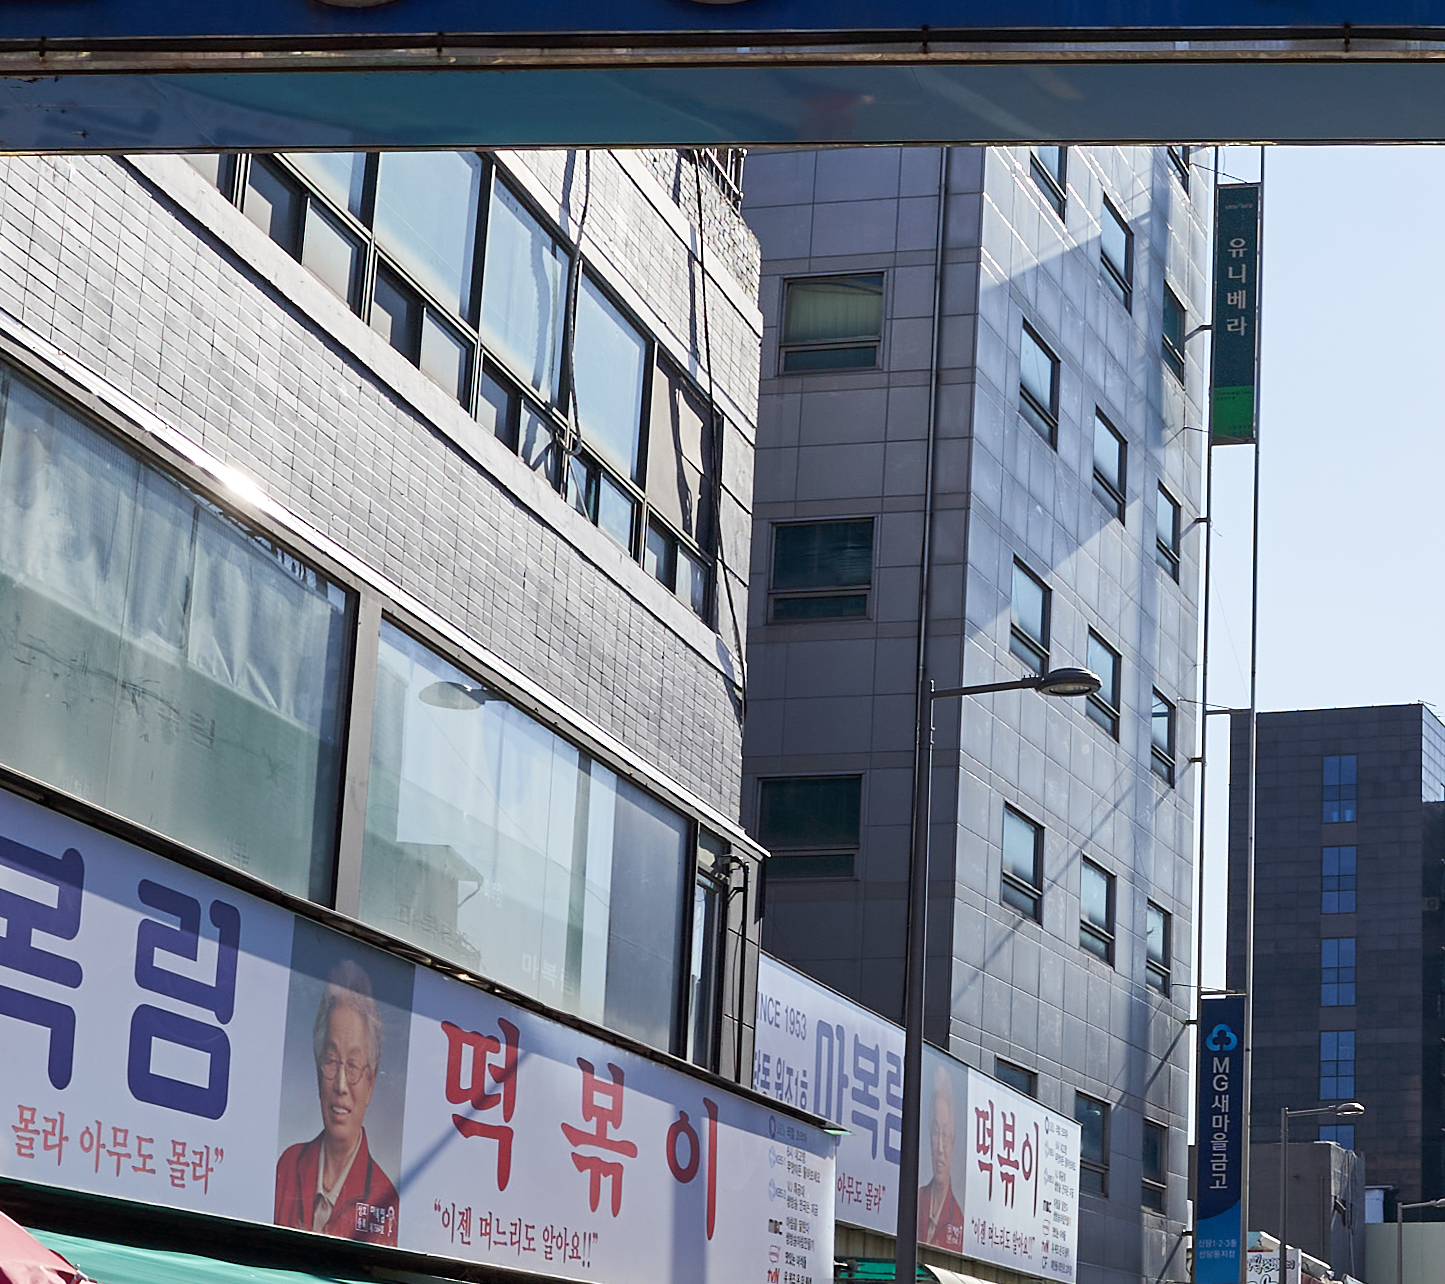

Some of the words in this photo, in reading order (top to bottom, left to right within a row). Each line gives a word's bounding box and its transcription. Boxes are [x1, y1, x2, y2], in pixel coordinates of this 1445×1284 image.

[784, 1004, 807, 1041] 1953
[440, 1017, 719, 1241] 떡볶이
[813, 1019, 905, 1166] 마복림
[1209, 1056, 1231, 1190] MG새마을금고
[11, 1104, 69, 1168] 몰라
[78, 1119, 157, 1179] 아무도
[838, 1172, 862, 1203] 아무도
[974, 1099, 1039, 1218] 떡볶이
[479, 1211, 537, 1252] 며느리도
